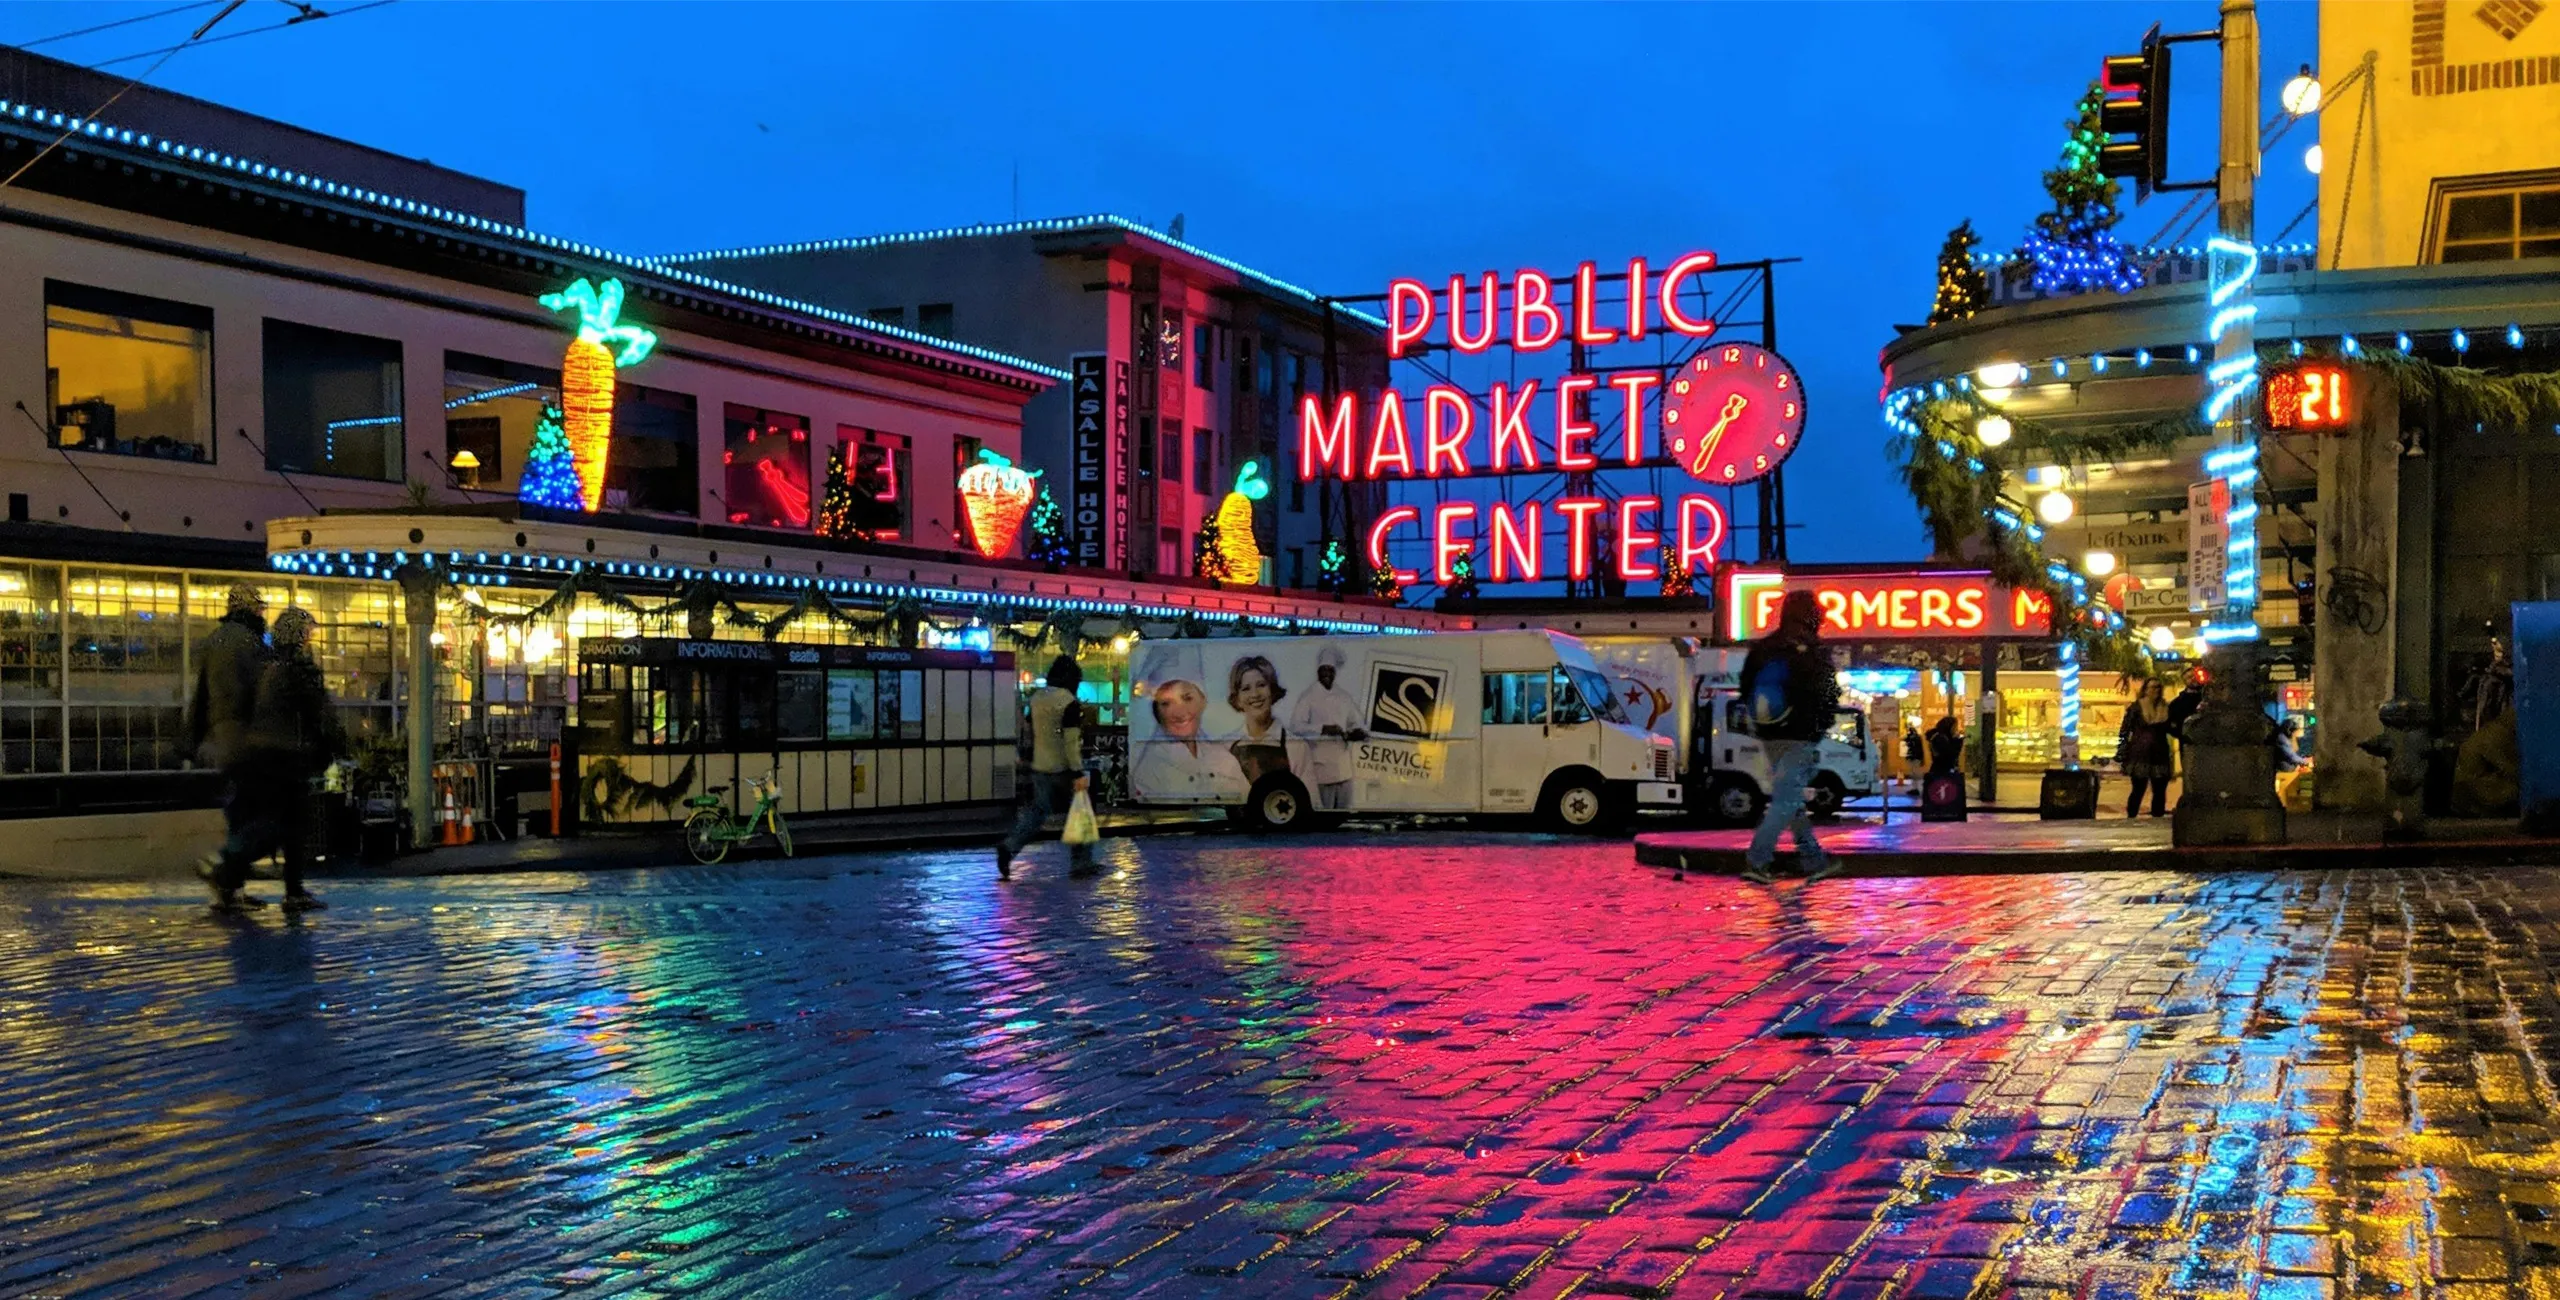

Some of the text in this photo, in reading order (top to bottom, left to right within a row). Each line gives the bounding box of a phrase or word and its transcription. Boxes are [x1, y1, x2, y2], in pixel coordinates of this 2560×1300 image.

[1387, 250, 1717, 359] PUBLIC
[1724, 348, 1740, 362] 12
[1757, 354, 1765, 368] 1
[1695, 358, 1709, 372] 11
[1079, 361, 1099, 393] LA
[1116, 362, 1128, 396] LA
[1776, 374, 1788, 388] 2
[1675, 380, 1690, 395] 10
[2301, 373, 2341, 421] 21
[1667, 412, 1679, 424] 9
[1784, 403, 1795, 418] 3
[1299, 370, 1663, 483] MARKET
[1079, 399, 1099, 482] SALLE
[1116, 403, 1128, 486] SALLE
[1674, 438, 1686, 453] 8
[1775, 433, 1787, 448] 4
[1756, 455, 1767, 470] 5
[1724, 464, 1736, 478] 6
[1367, 493, 1728, 587] CENTER
[1756, 589, 1982, 629] FRMERS
[677, 642, 758, 660] INFORMATION
[866, 651, 911, 663] INFORMATION
[1358, 744, 1433, 772] SERVICE
[1356, 761, 1431, 780] LINEN SUPPLY
